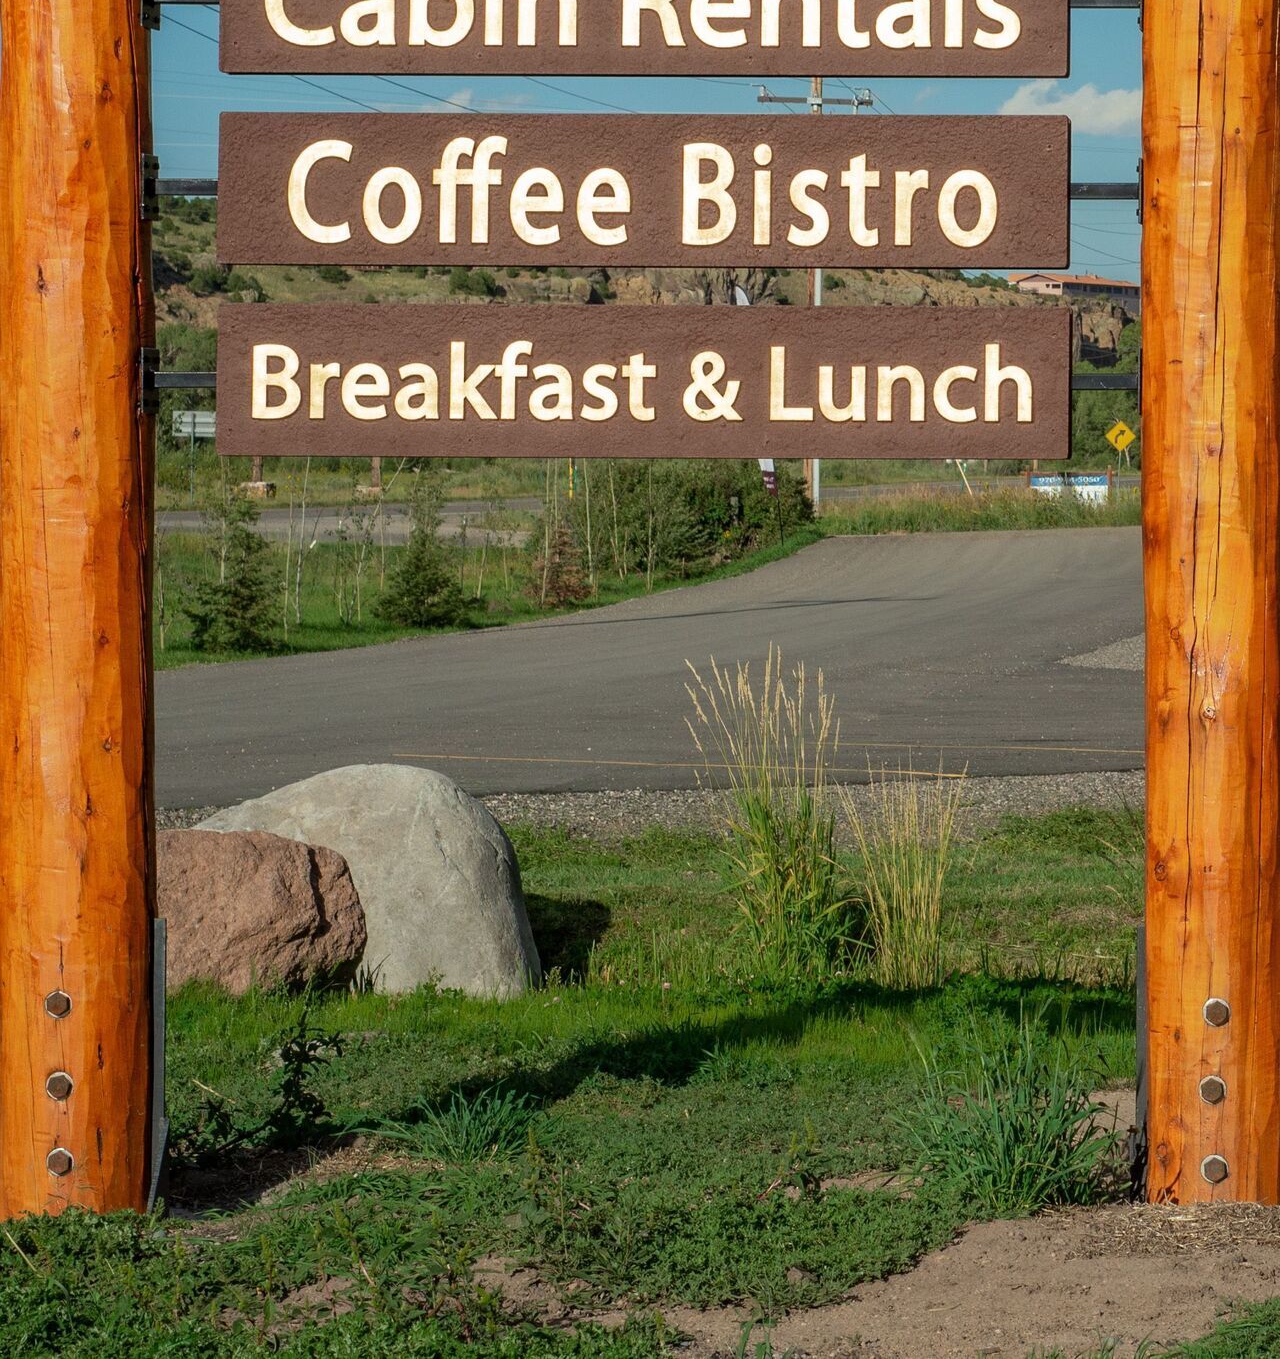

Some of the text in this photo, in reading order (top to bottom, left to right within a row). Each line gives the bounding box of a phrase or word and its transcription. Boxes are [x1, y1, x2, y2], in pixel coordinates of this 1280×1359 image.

[286, 134, 999, 249] Coffee Bistro
[250, 339, 1034, 424] Breakfast & Lunch
